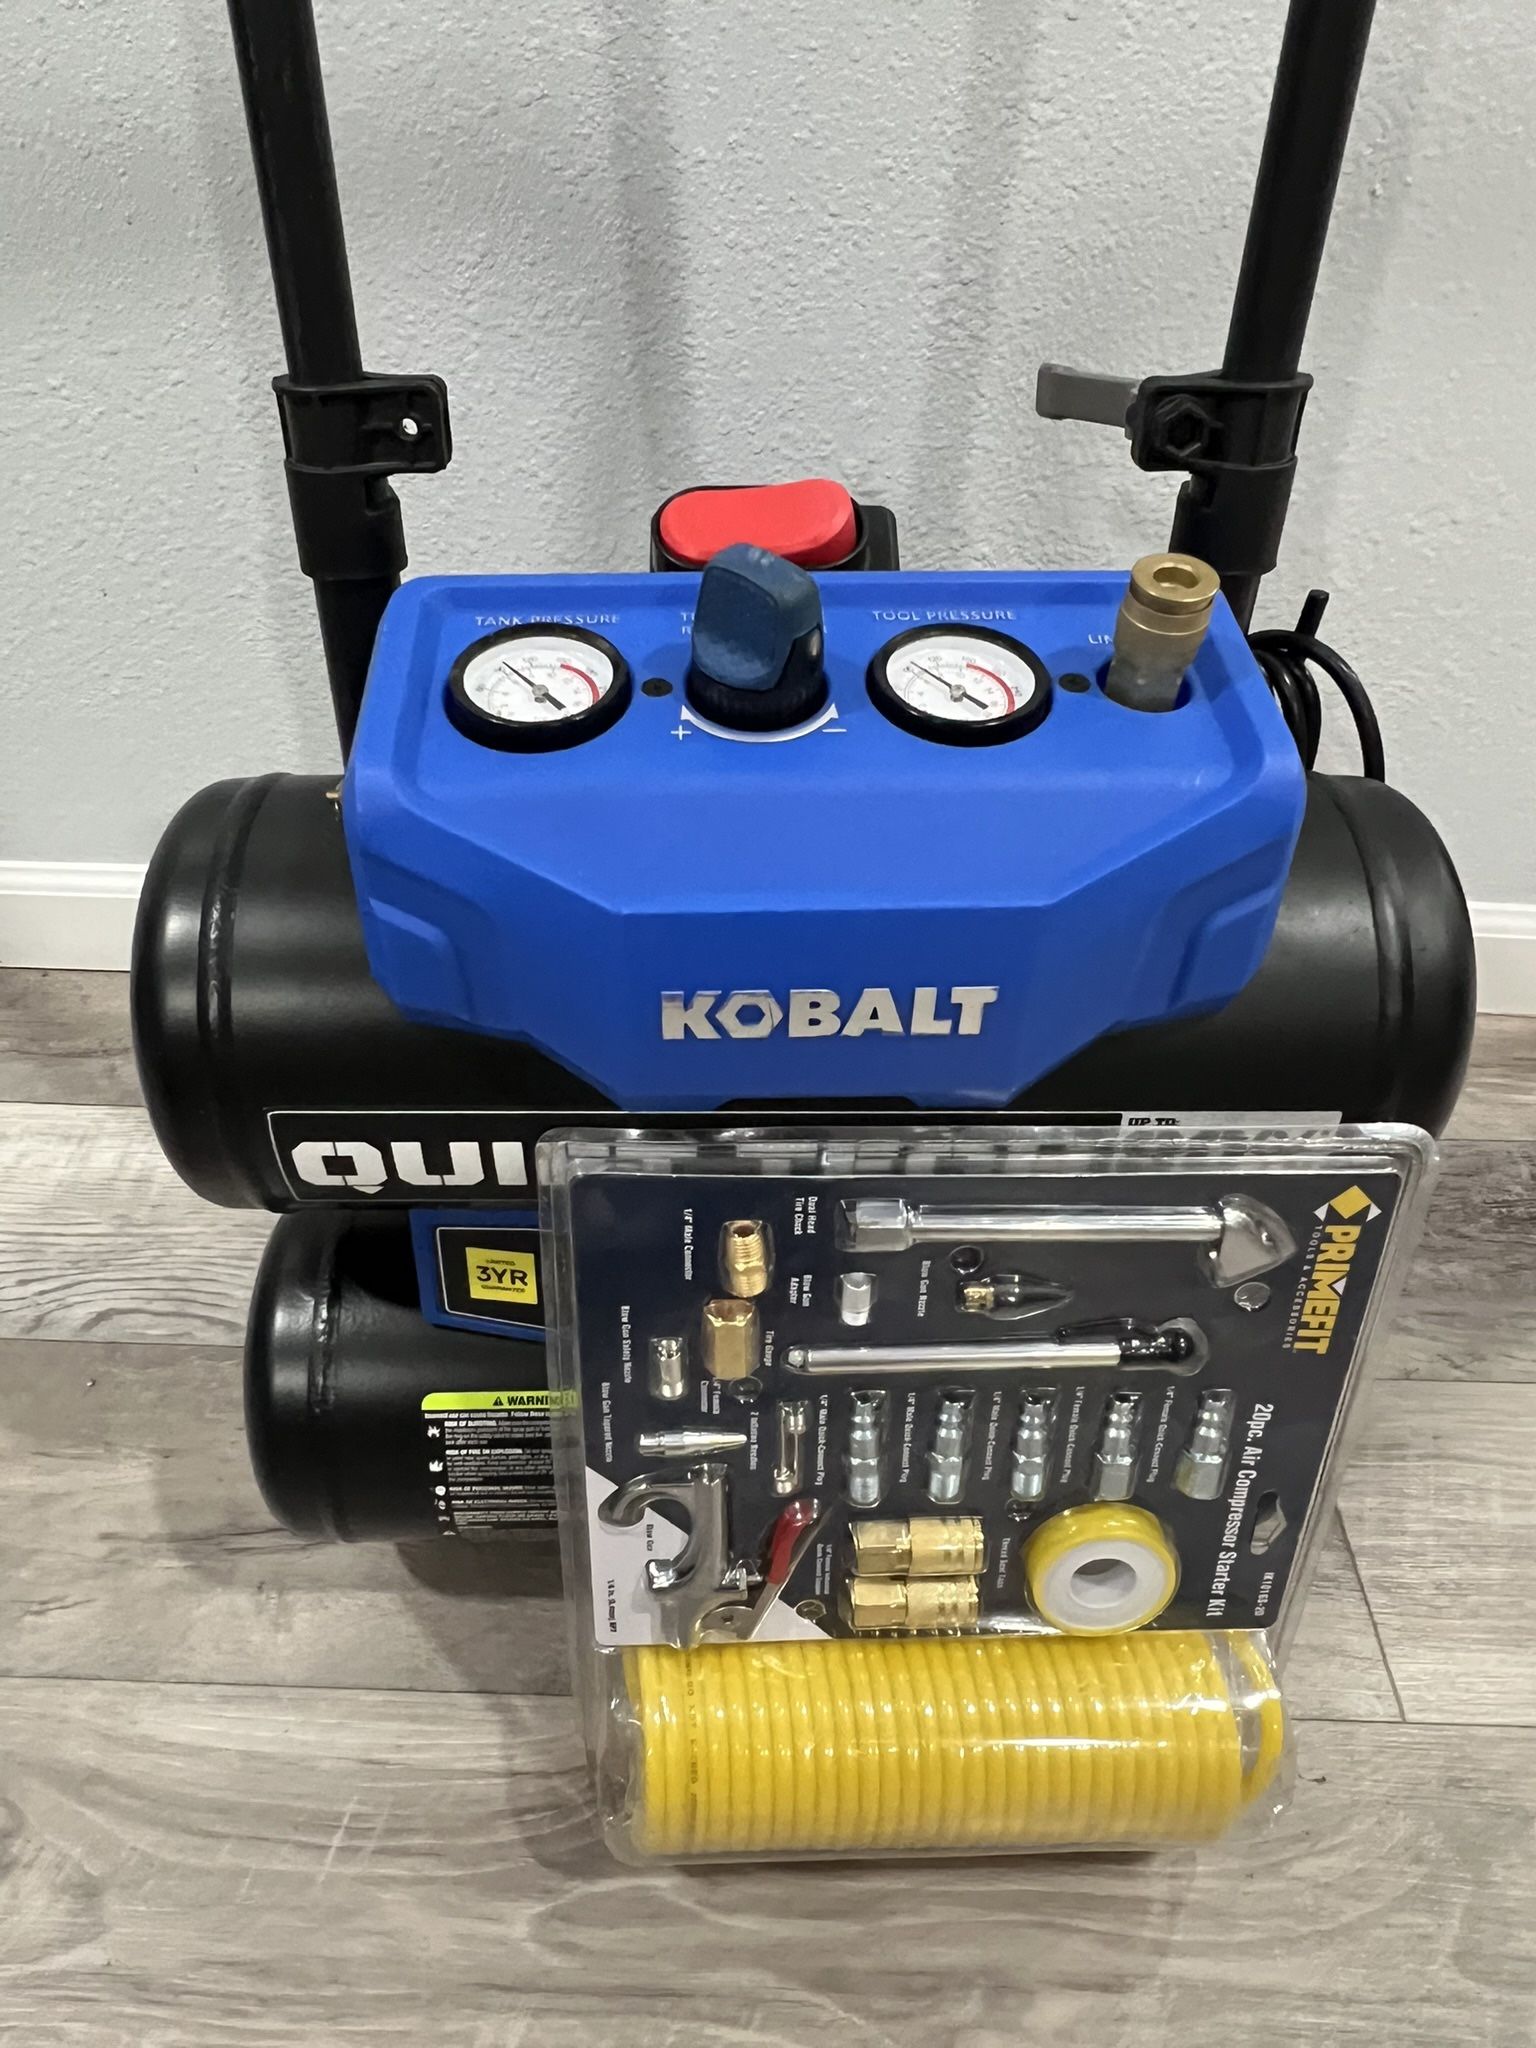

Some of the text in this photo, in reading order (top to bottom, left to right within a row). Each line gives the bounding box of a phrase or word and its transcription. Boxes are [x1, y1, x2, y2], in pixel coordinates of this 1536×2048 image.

[475, 613, 620, 626] TANK PRESSURE
[872, 609, 1017, 621] TOOL PRESSURE
[660, 985, 1000, 1040] KOBALT
[291, 1141, 528, 1194] QUI
[793, 1197, 804, 1235] Tire Chuck
[807, 1196, 818, 1234] Dual Head
[683, 1208, 694, 1280] 1/4" Male Connector
[1305, 1225, 1323, 1260] TOOLS
[476, 1265, 528, 1286] 3YR
[919, 1279, 930, 1294] Gun
[789, 1277, 800, 1304] Adapter
[801, 1293, 812, 1307] Gun
[1293, 1225, 1362, 1355] PRIMEFIT
[1282, 1277, 1309, 1349] ACCESSORIES
[621, 1324, 631, 1338] Gun
[763, 1330, 774, 1366] Tire Gauge
[507, 1395, 556, 1406] WARNI
[814, 1471, 825, 1486] Plug
[899, 1469, 910, 1483] Plug
[981, 1466, 993, 1481] Plug
[1146, 1468, 1159, 1483] Plug
[1205, 1403, 1274, 1617] 20pc. Air Compressor Starter Kit
